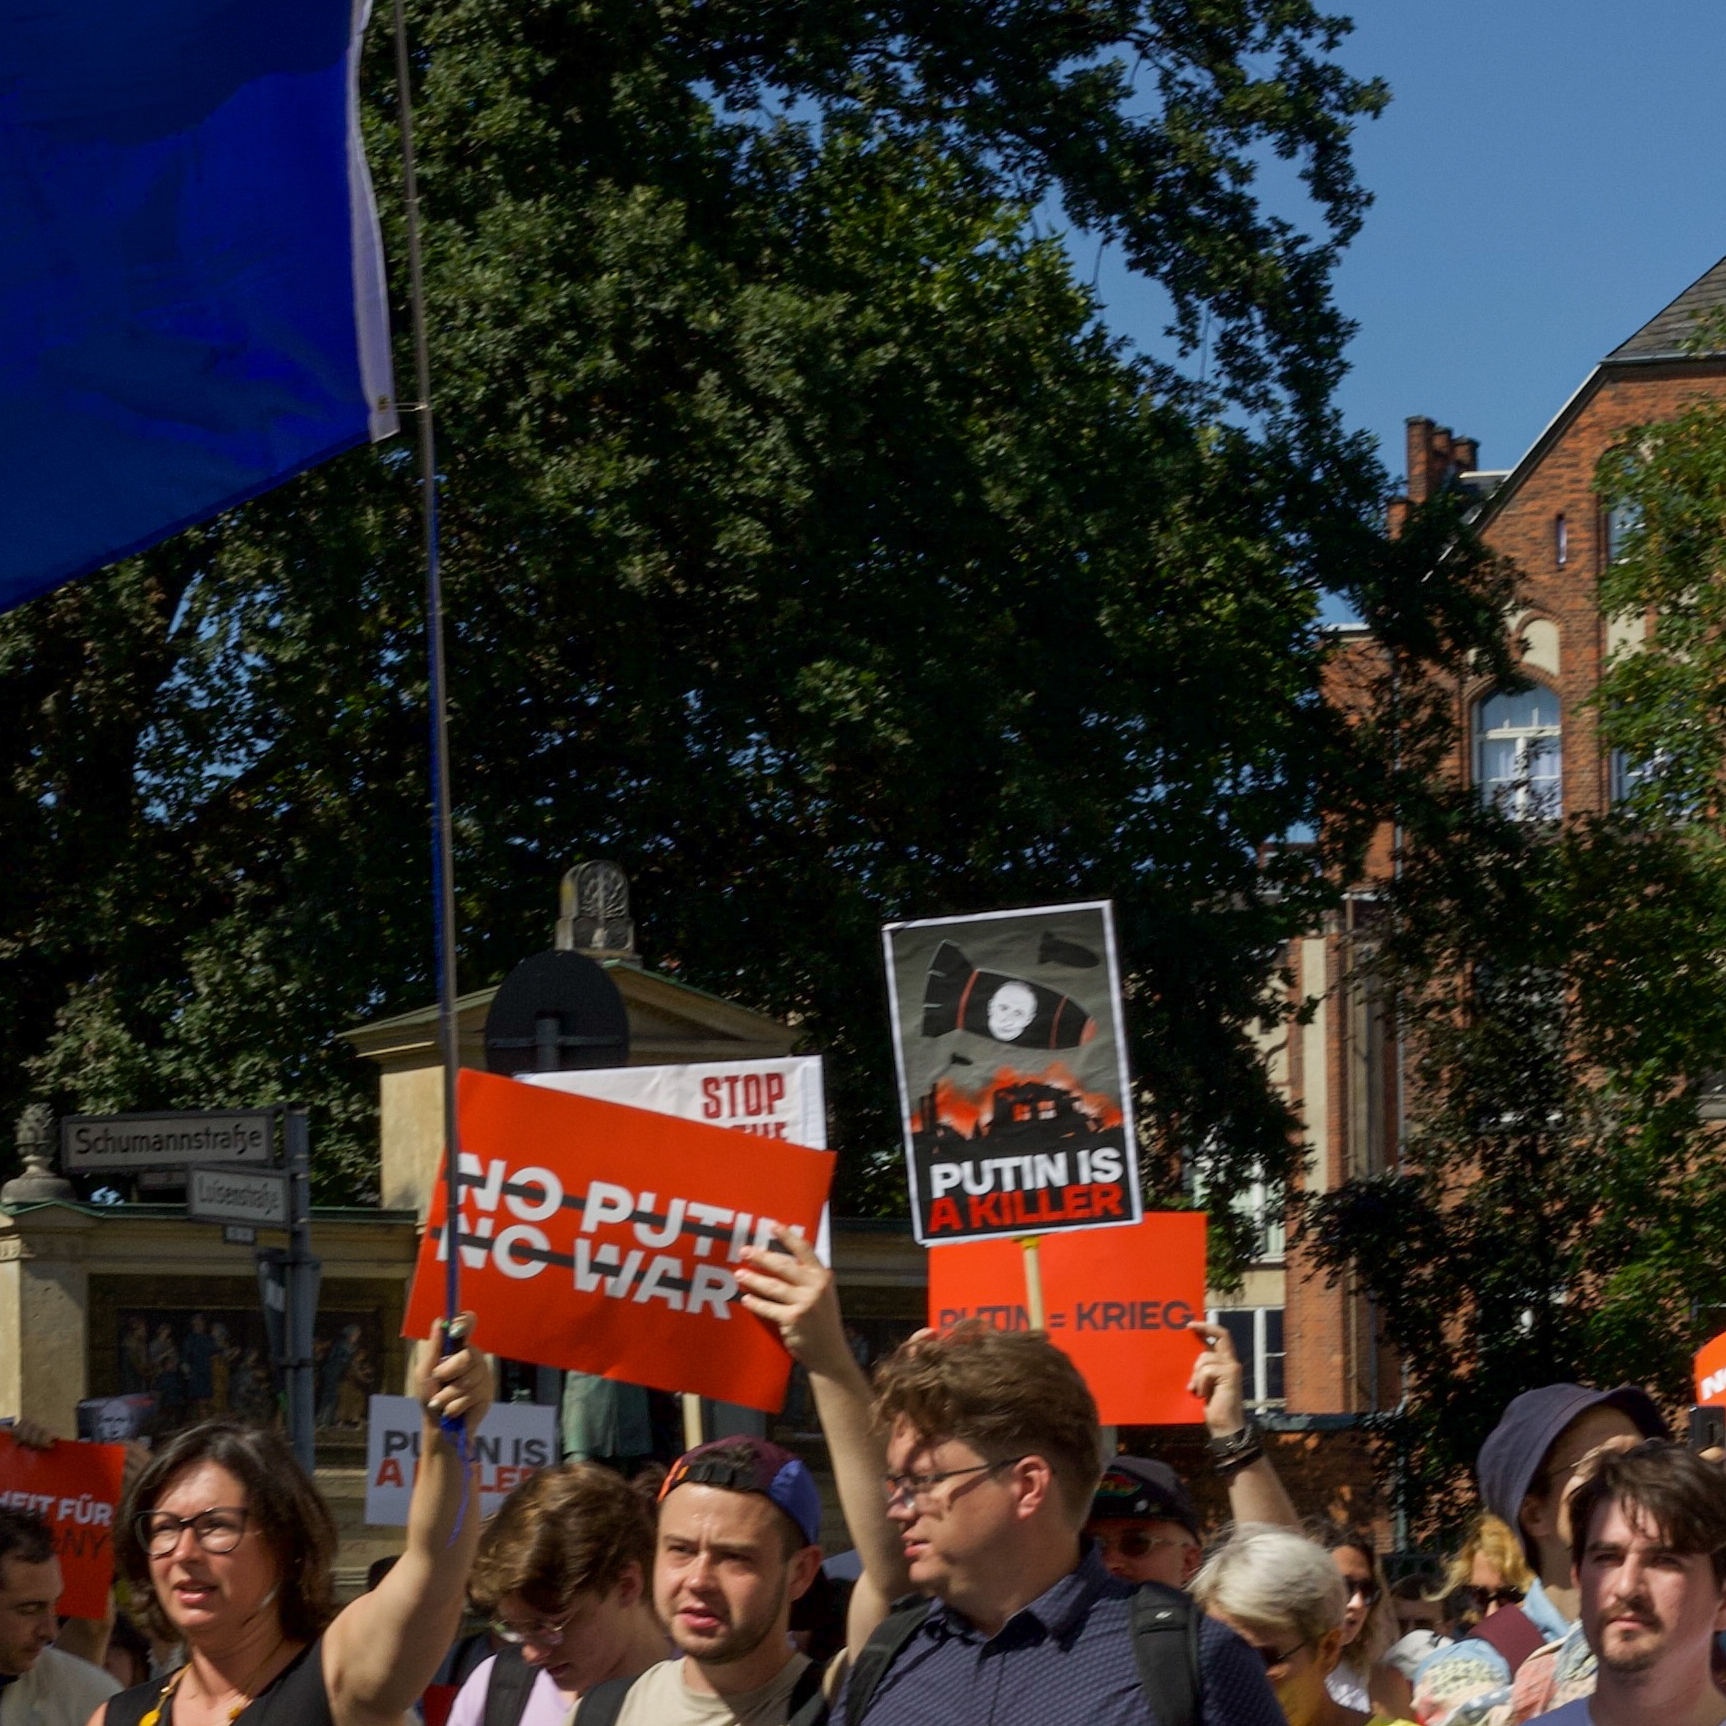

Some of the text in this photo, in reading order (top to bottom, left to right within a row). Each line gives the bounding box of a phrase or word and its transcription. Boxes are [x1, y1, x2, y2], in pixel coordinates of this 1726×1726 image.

[702, 1072, 785, 1119] STOP
[930, 1147, 1123, 1199] PUTIN IS
[458, 1152, 806, 1264] NO PUTIN
[929, 1182, 1123, 1233] A KILLER
[436, 1213, 741, 1320] NO WAR
[1076, 1301, 1195, 1331] KRIEG
[376, 1458, 405, 1488] A
[57, 1492, 114, 1527] FÜR
